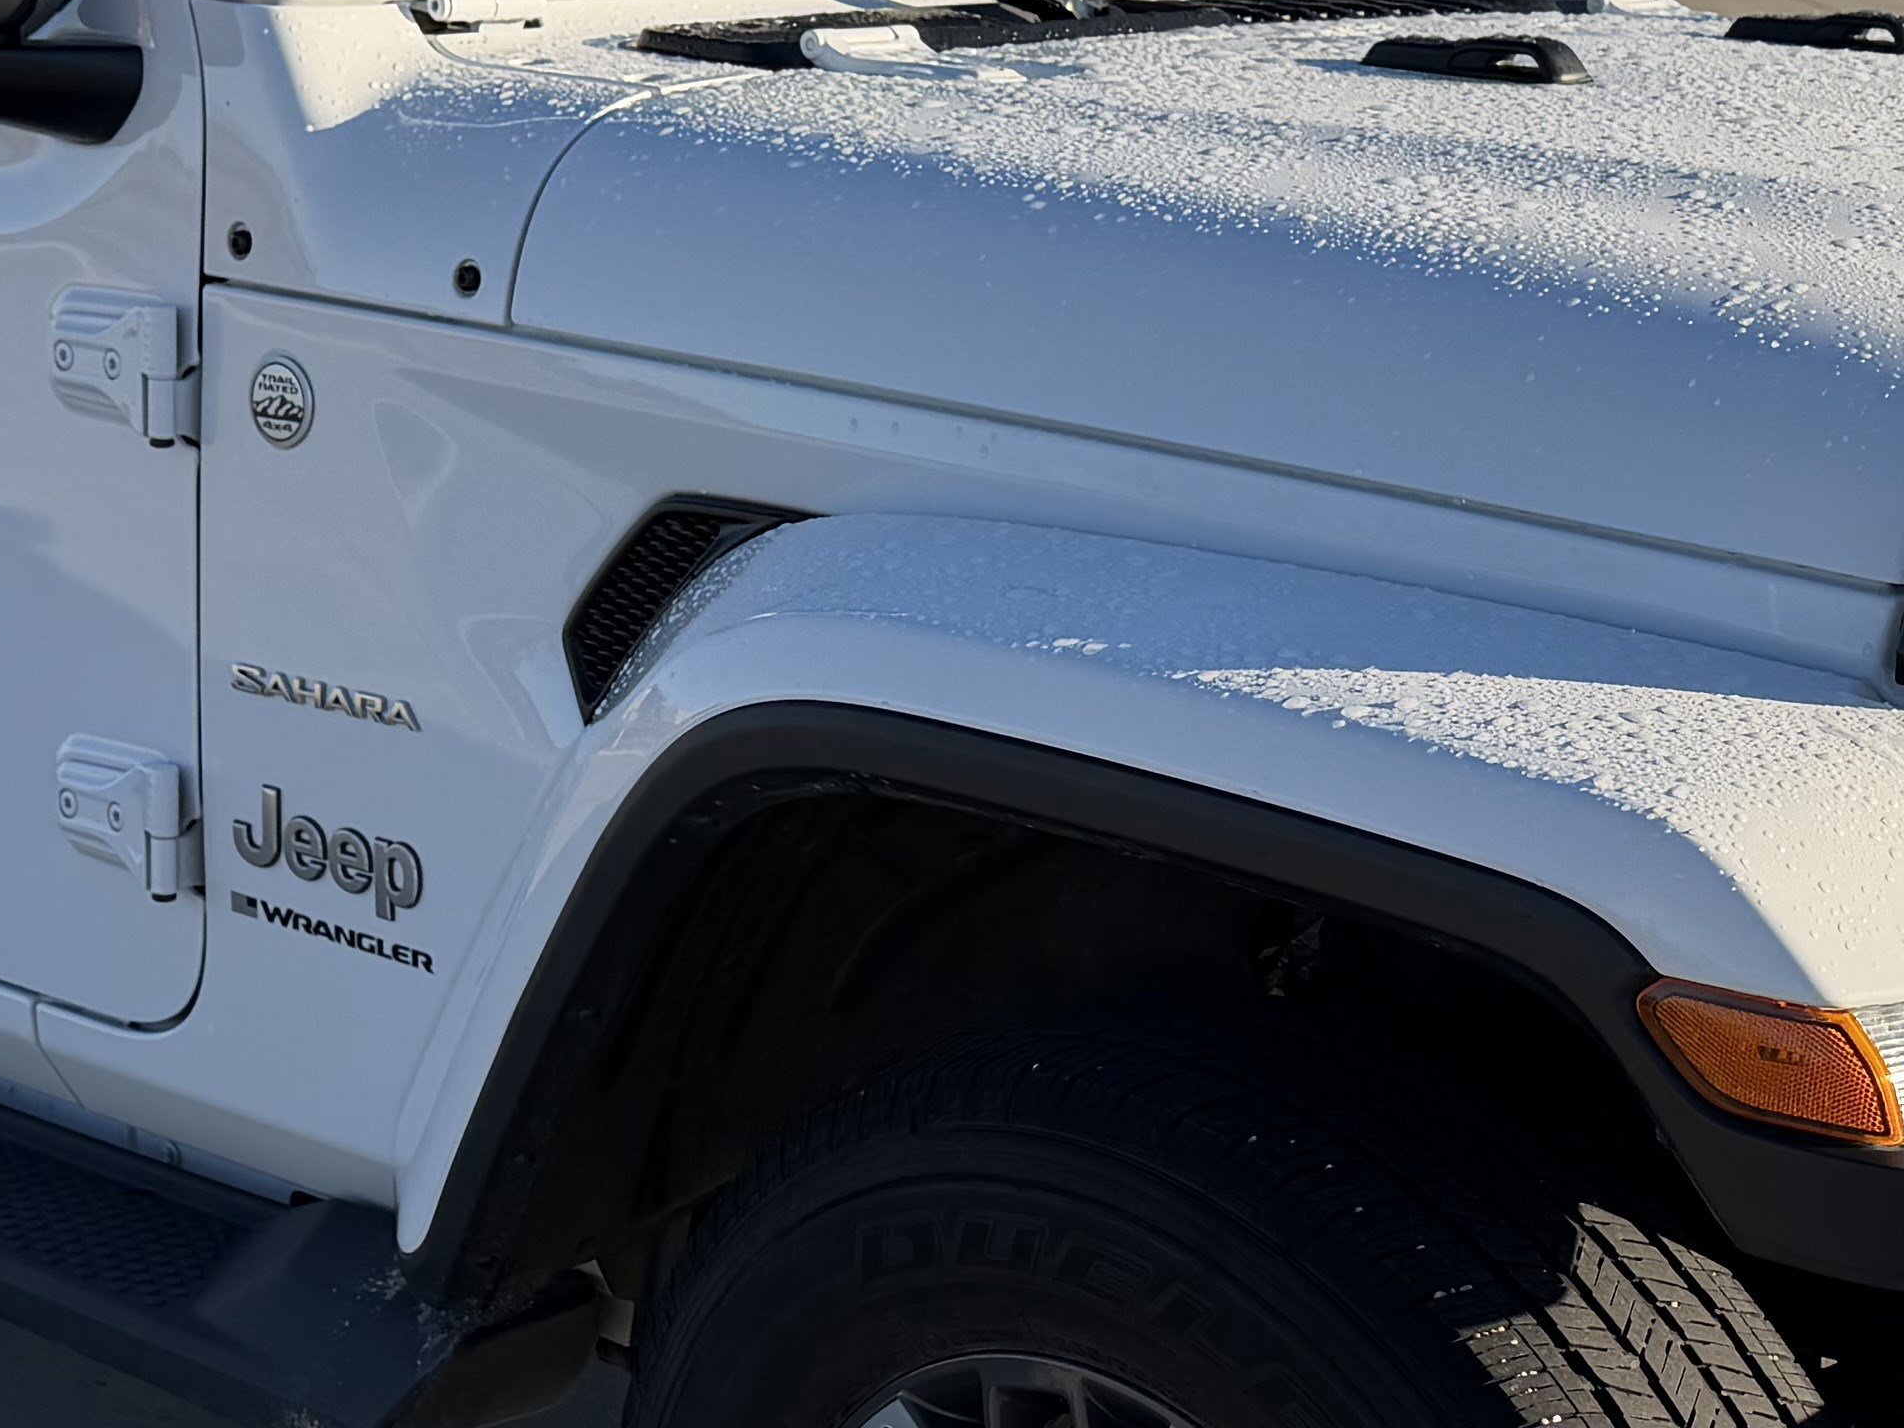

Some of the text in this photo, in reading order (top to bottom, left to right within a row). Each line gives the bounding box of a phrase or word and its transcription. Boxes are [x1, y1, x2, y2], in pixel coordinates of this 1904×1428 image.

[231, 663, 422, 732] SAHARA
[232, 784, 423, 922] Jeep
[260, 899, 435, 974] WRANGLER
